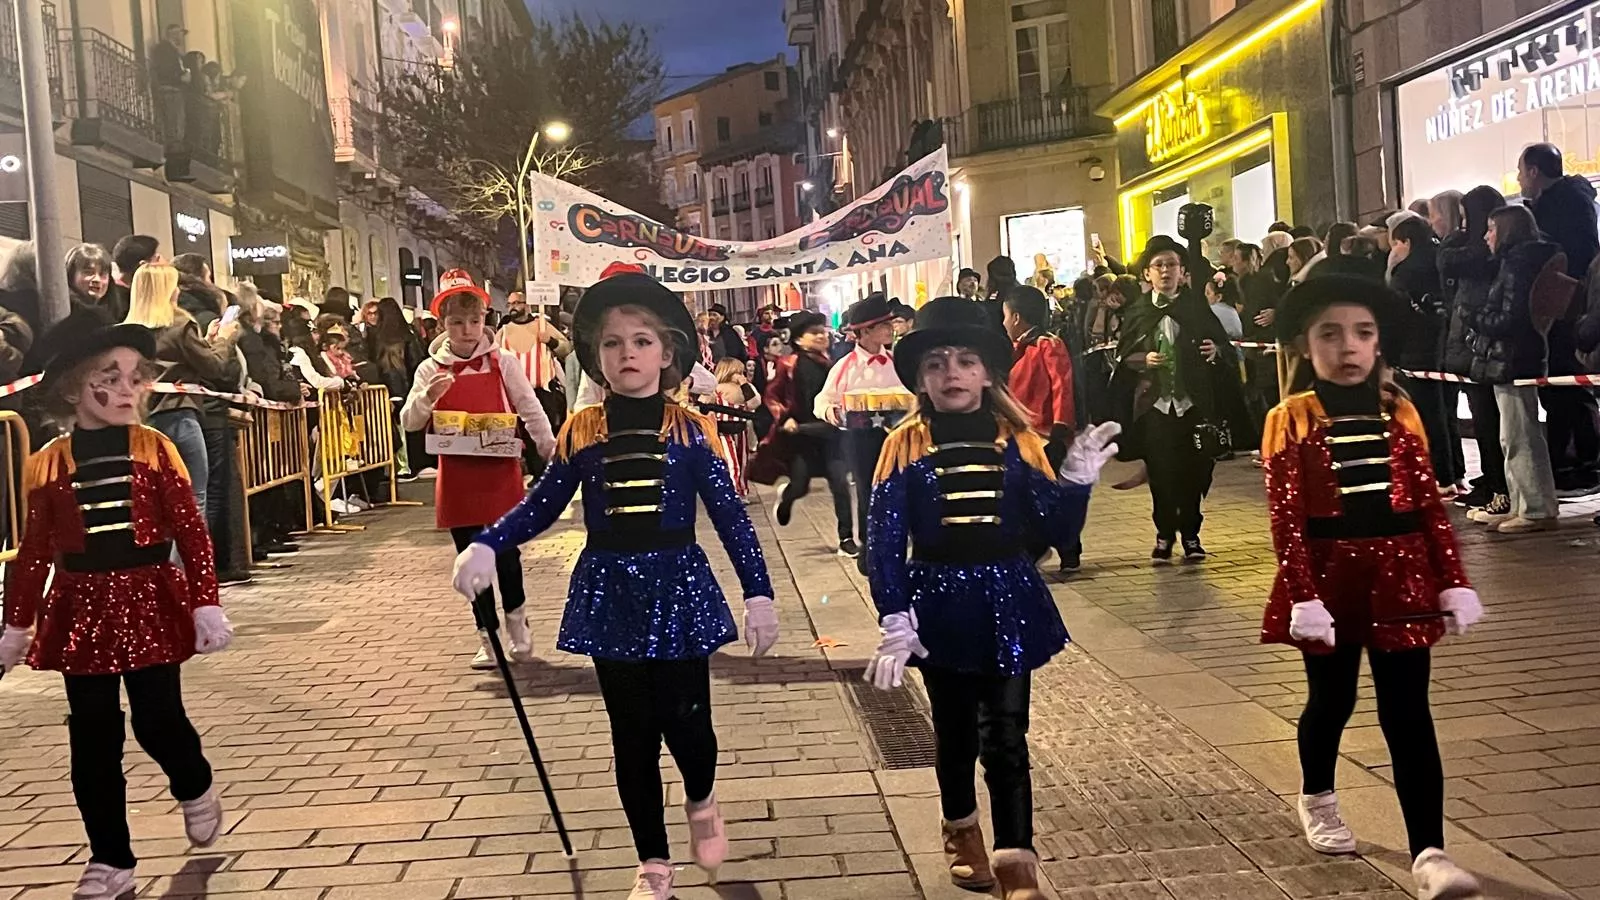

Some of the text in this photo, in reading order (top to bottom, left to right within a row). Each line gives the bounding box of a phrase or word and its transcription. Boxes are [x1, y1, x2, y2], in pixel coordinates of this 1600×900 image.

[1425, 99, 1485, 144] NÚÑEZ
[1491, 88, 1519, 123] DE
[232, 245, 287, 259] MANGO
[646, 240, 911, 284] LEGIO SANTA ANA
